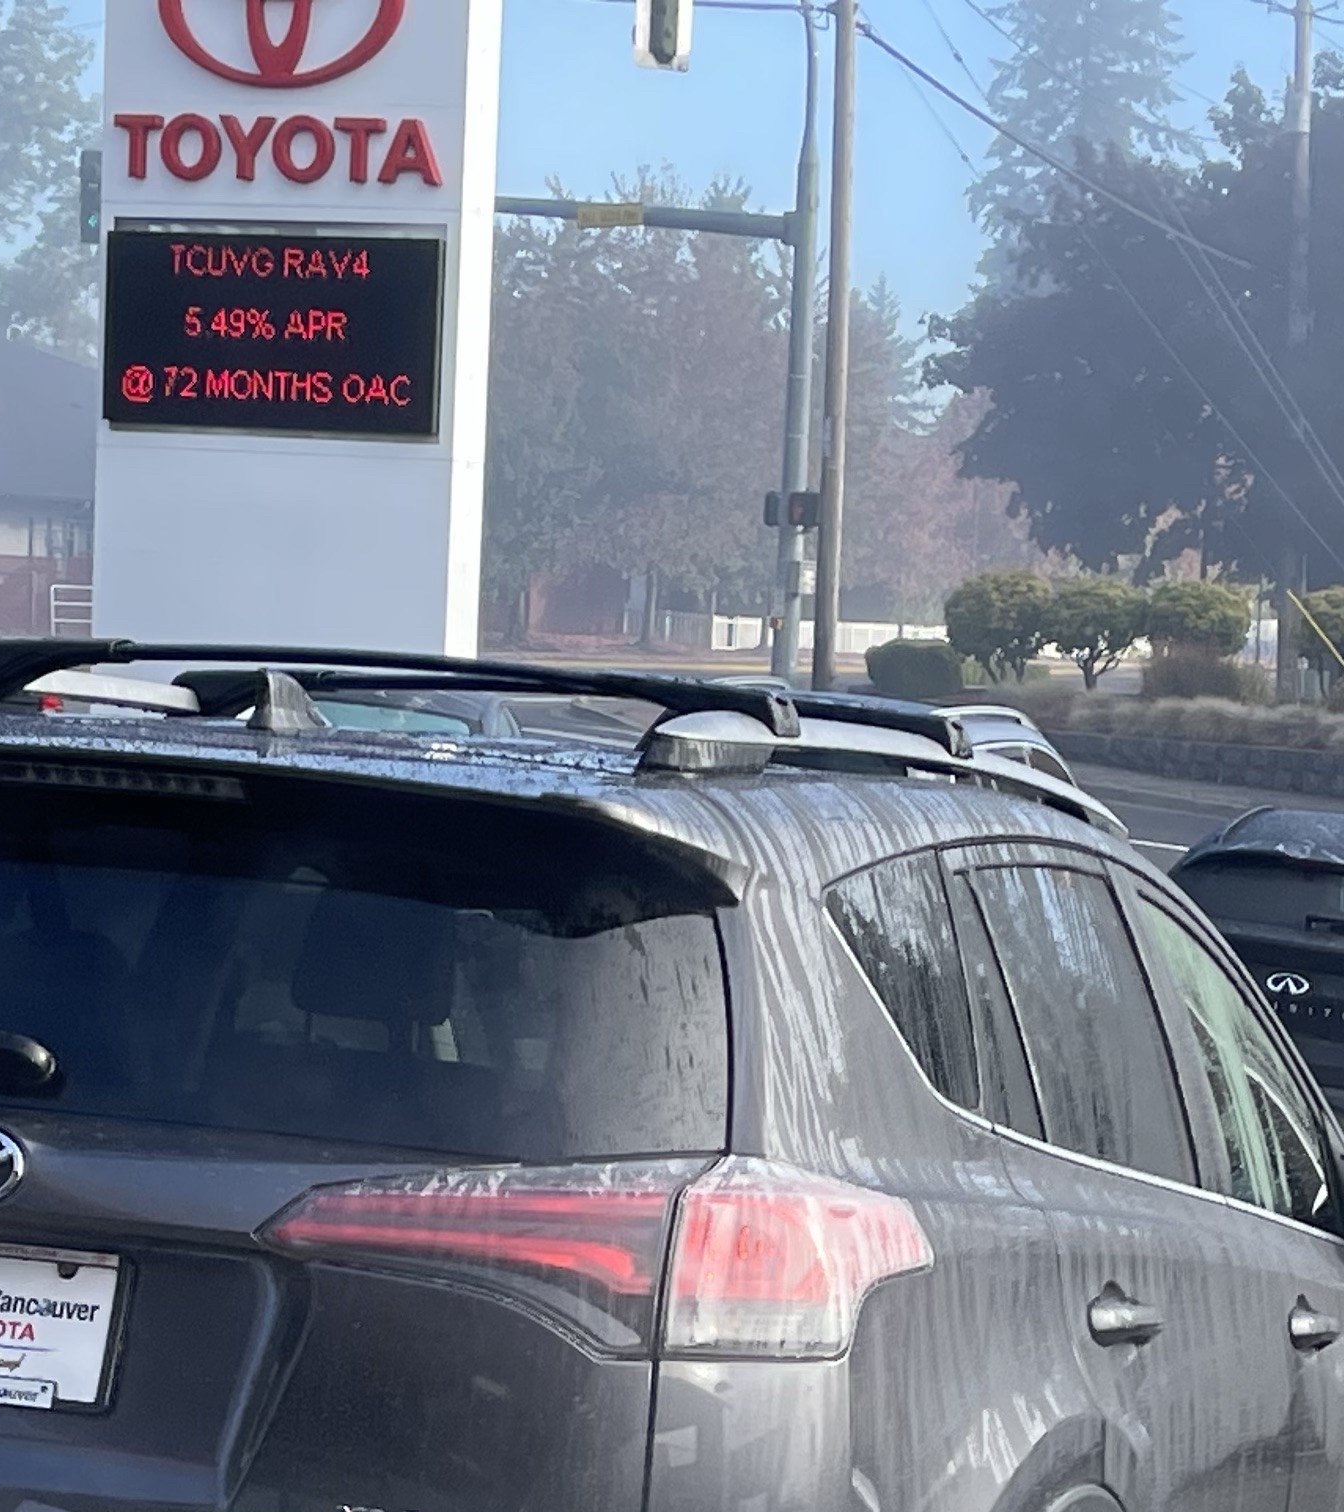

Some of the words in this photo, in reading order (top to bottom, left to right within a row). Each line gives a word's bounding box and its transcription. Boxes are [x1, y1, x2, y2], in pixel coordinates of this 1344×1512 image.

[113, 112, 443, 187] TOYOTA
[282, 247, 371, 279] RAV4
[283, 309, 349, 341] APR
[121, 364, 154, 403] @
[163, 366, 198, 399] 72
[204, 369, 332, 404] MONTHS
[341, 372, 413, 407] OAC
